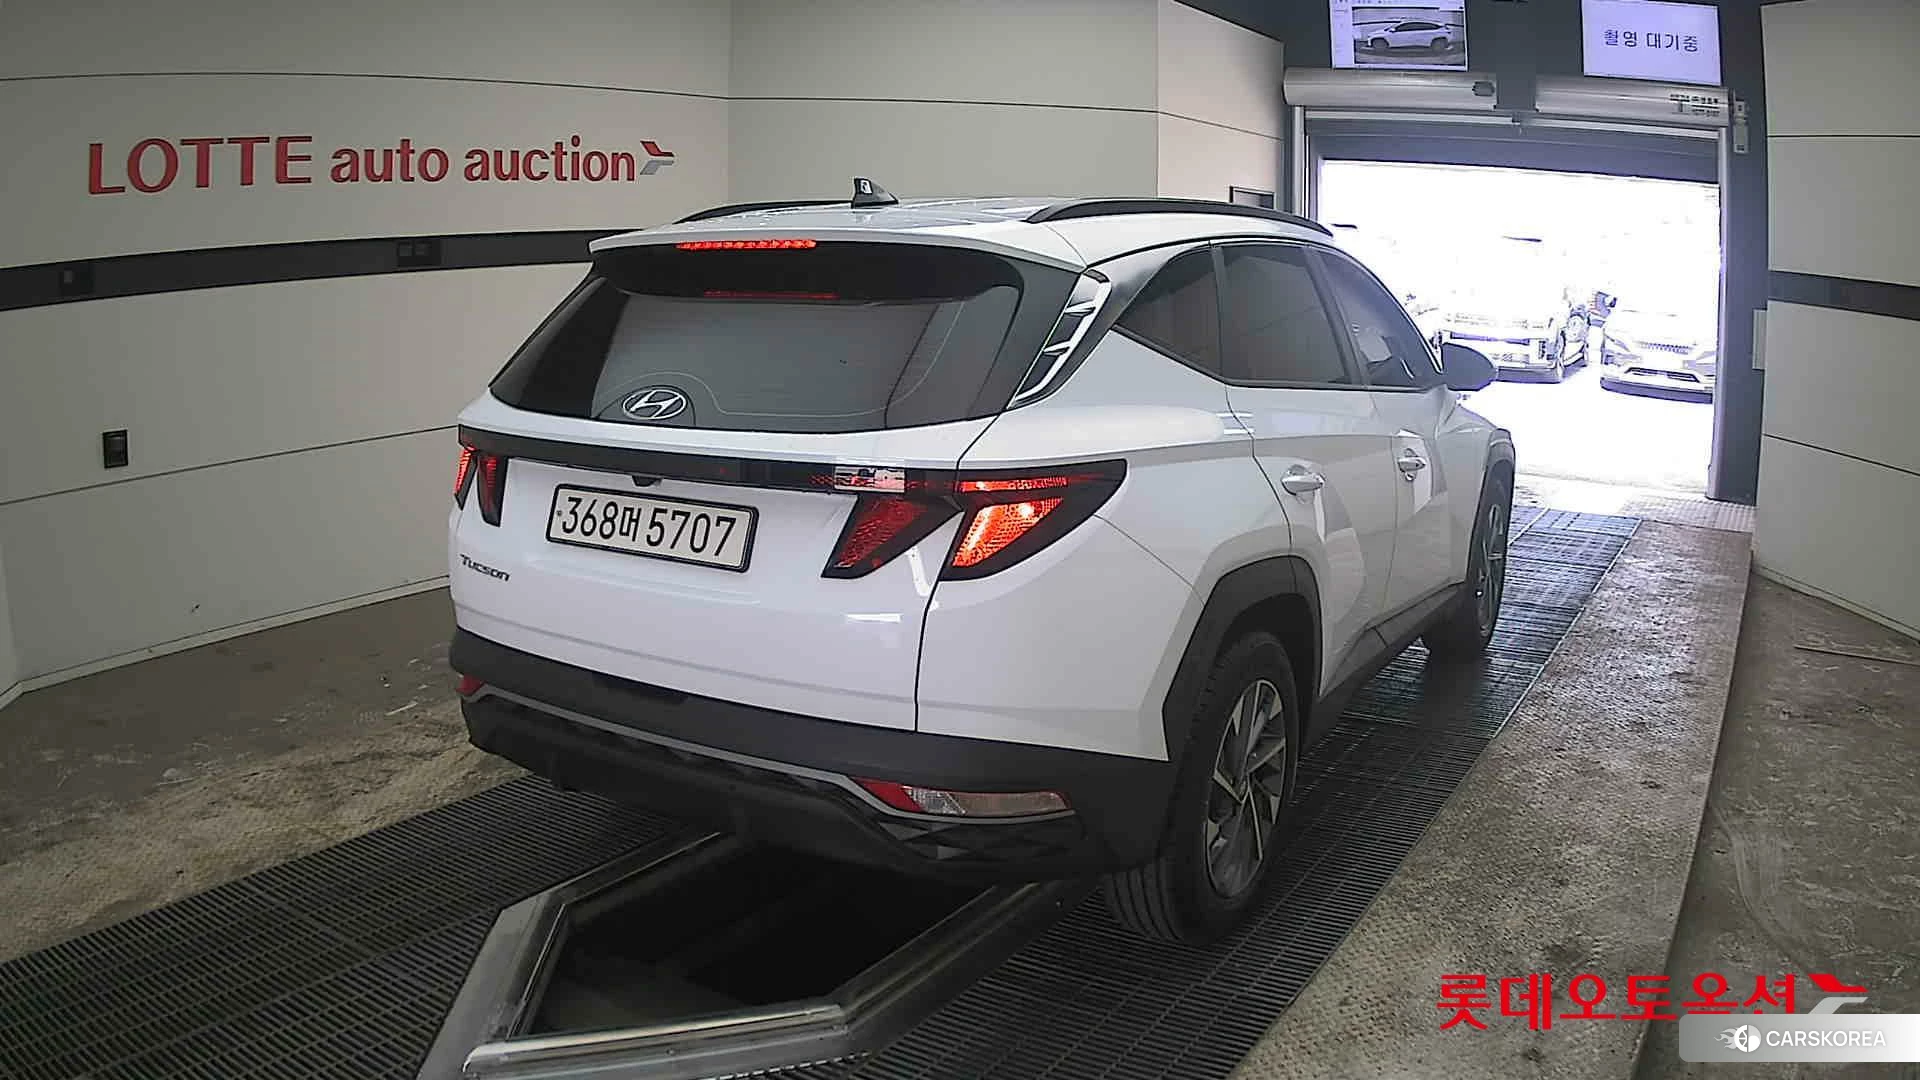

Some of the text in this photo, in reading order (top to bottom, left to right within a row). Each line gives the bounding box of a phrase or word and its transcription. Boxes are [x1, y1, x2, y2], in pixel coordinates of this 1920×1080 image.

[1646, 32, 1699, 53] 대기중
[88, 134, 636, 195] LOTTE auto auction
[561, 496, 737, 557] 368머 5707
